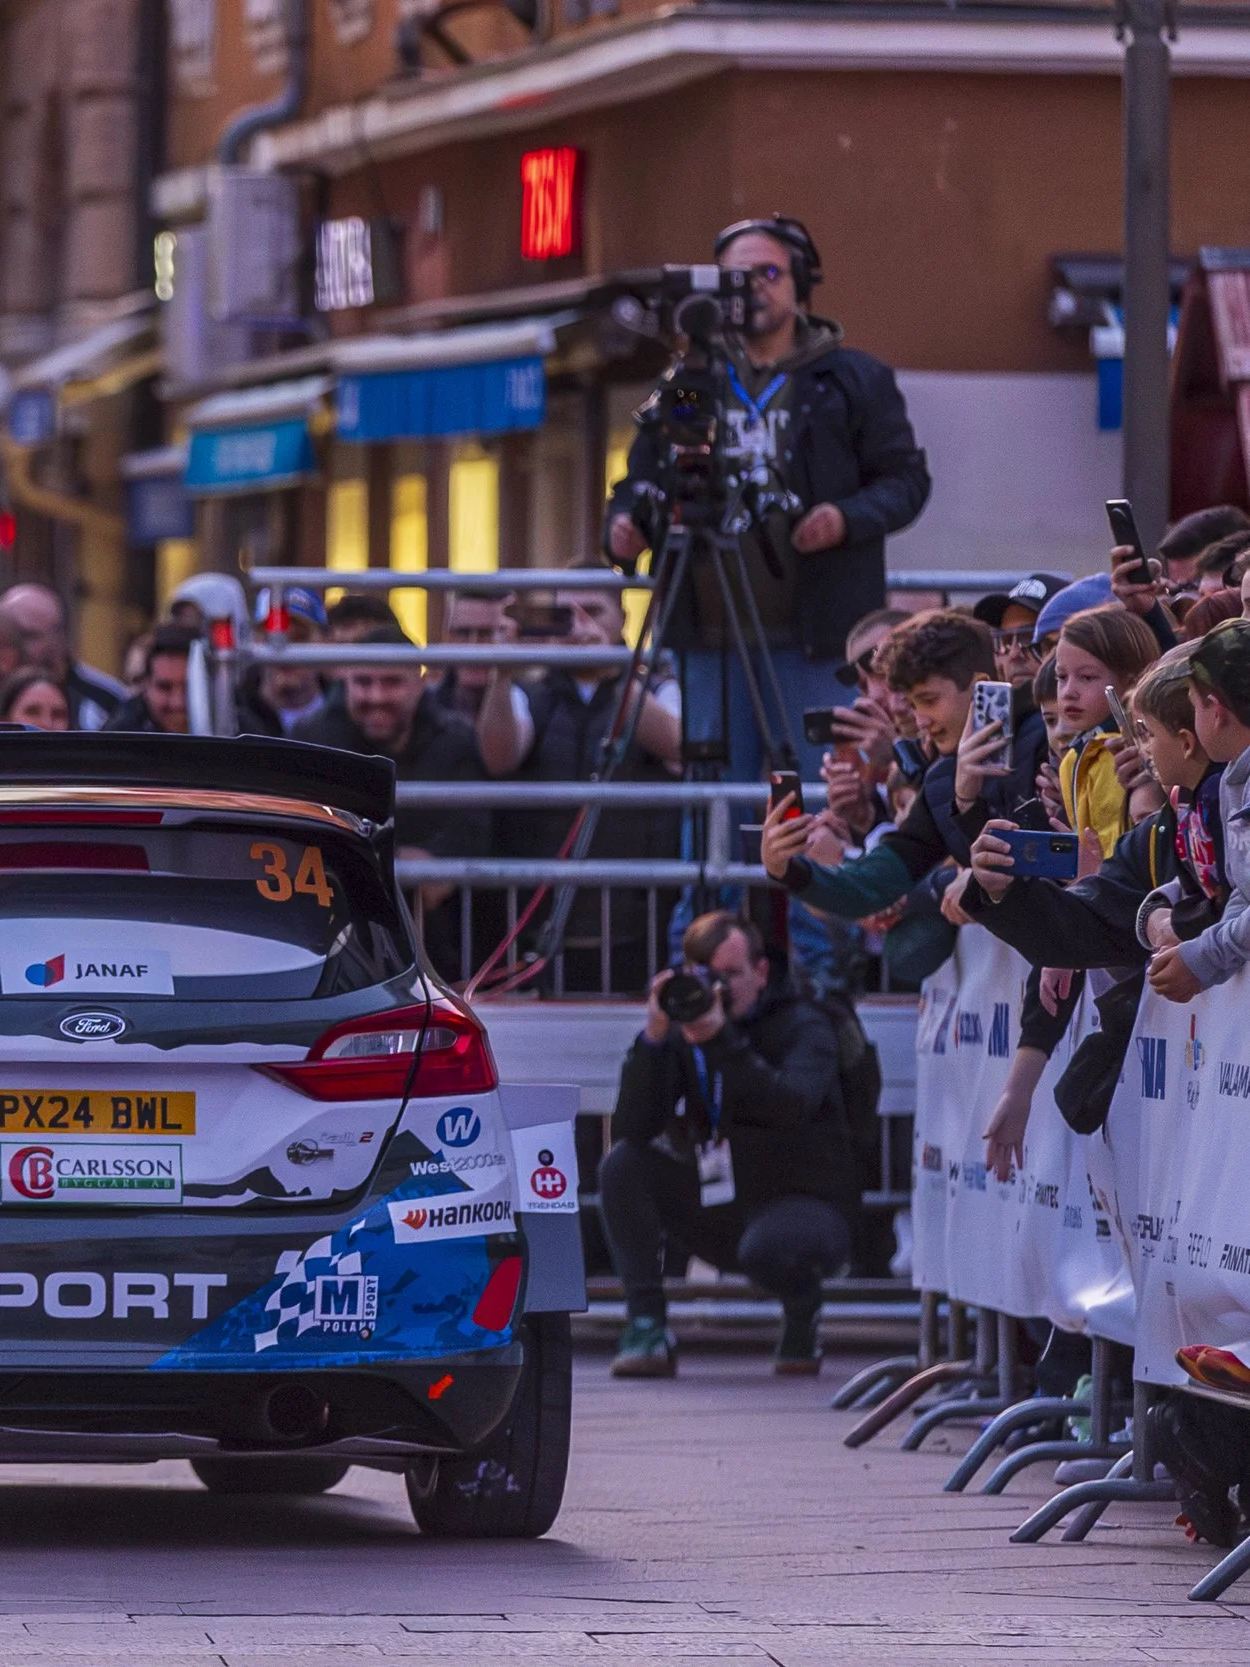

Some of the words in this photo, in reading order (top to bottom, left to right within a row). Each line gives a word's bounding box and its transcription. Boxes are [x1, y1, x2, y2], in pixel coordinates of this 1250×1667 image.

[250, 842, 334, 907] 34
[75, 964, 148, 979] JANAF
[75, 1018, 111, 1033] Ford
[111, 1097, 182, 1130] BWL
[56, 1158, 172, 1176] CARLSSON
[1219, 1243, 1250, 1275] FANAT
[365, 1279, 376, 1316] SPORT
